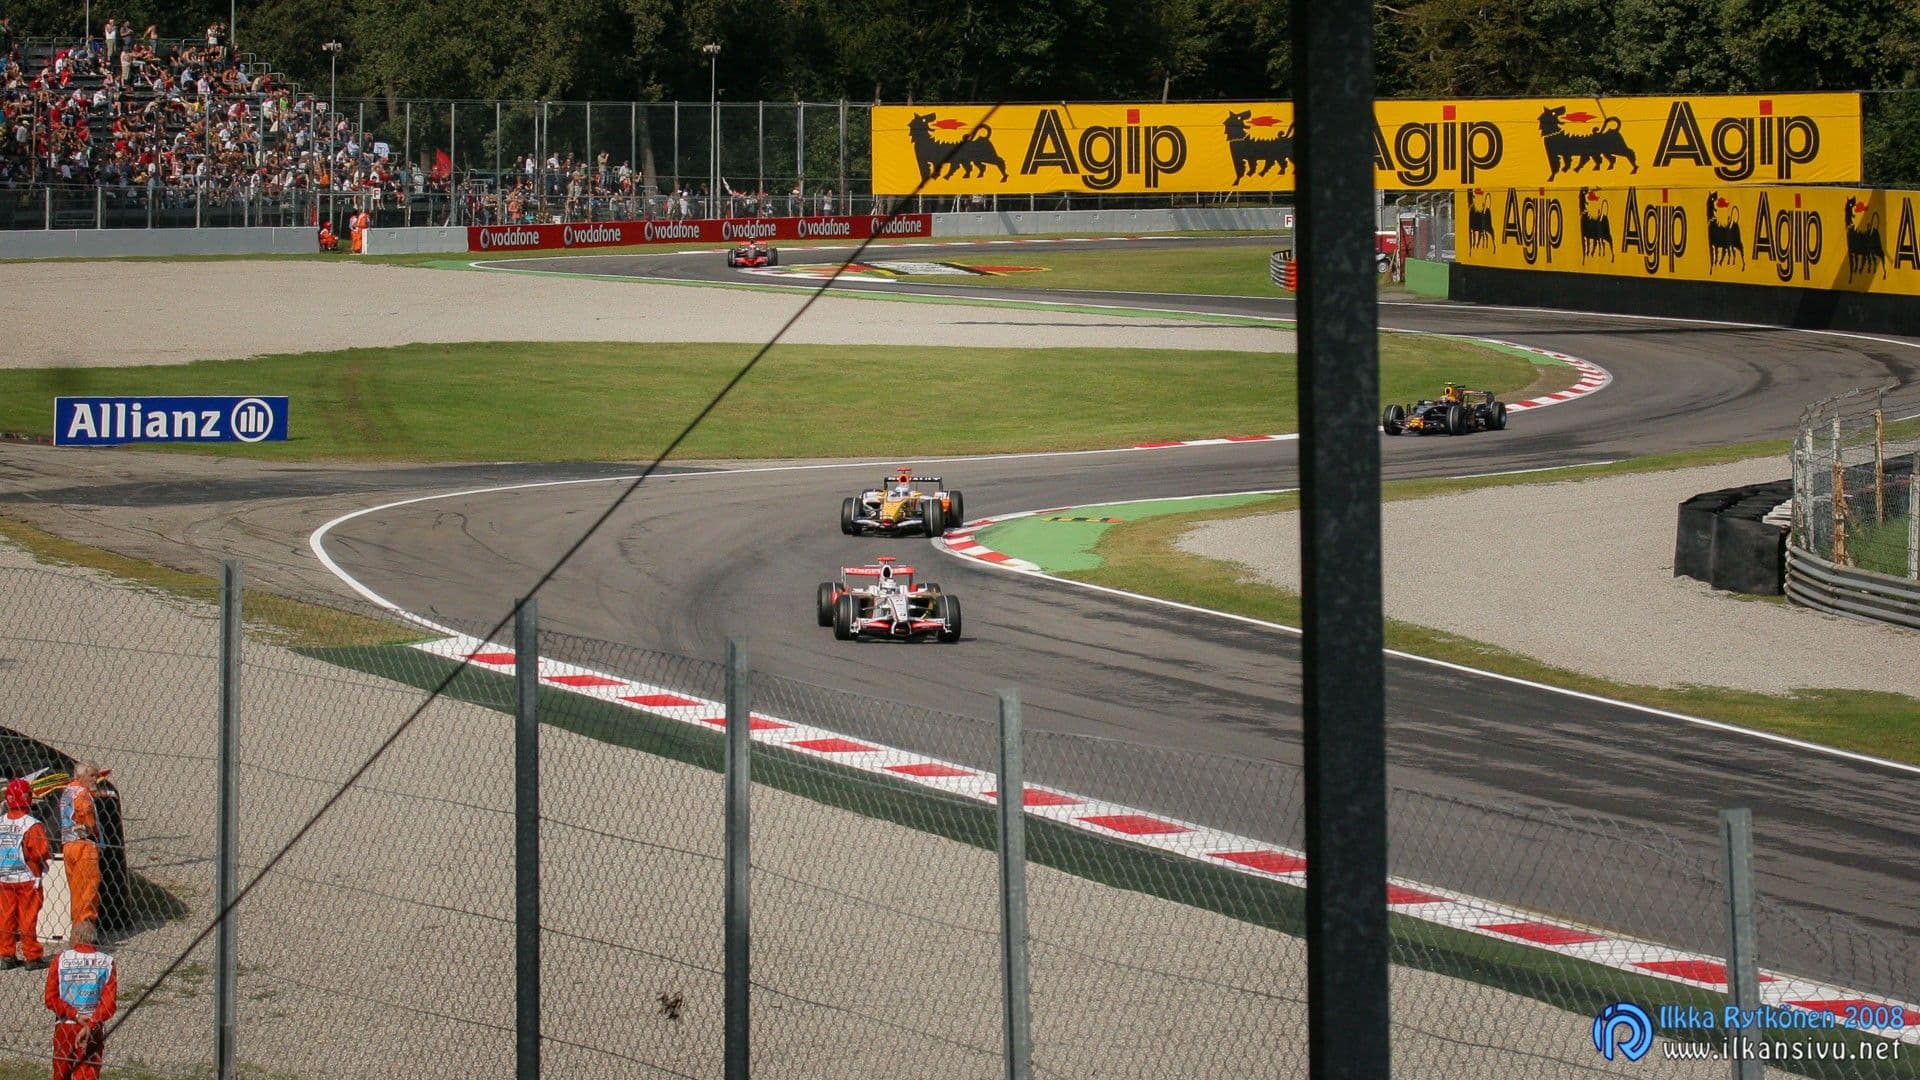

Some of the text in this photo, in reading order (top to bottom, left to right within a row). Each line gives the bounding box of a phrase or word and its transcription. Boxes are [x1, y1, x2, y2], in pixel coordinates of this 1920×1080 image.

[1020, 109, 1187, 190] Agip
[1652, 100, 1820, 182] Agip
[491, 227, 540, 246] vodafone
[574, 224, 621, 243] vodafone
[655, 220, 700, 239] vodafone
[732, 219, 777, 238] vodafone
[807, 217, 850, 236] vodafone
[1502, 187, 1563, 265] Agip
[1621, 187, 1688, 275] Agip
[1752, 191, 1823, 282] Agip
[67, 403, 221, 438] Allianz
